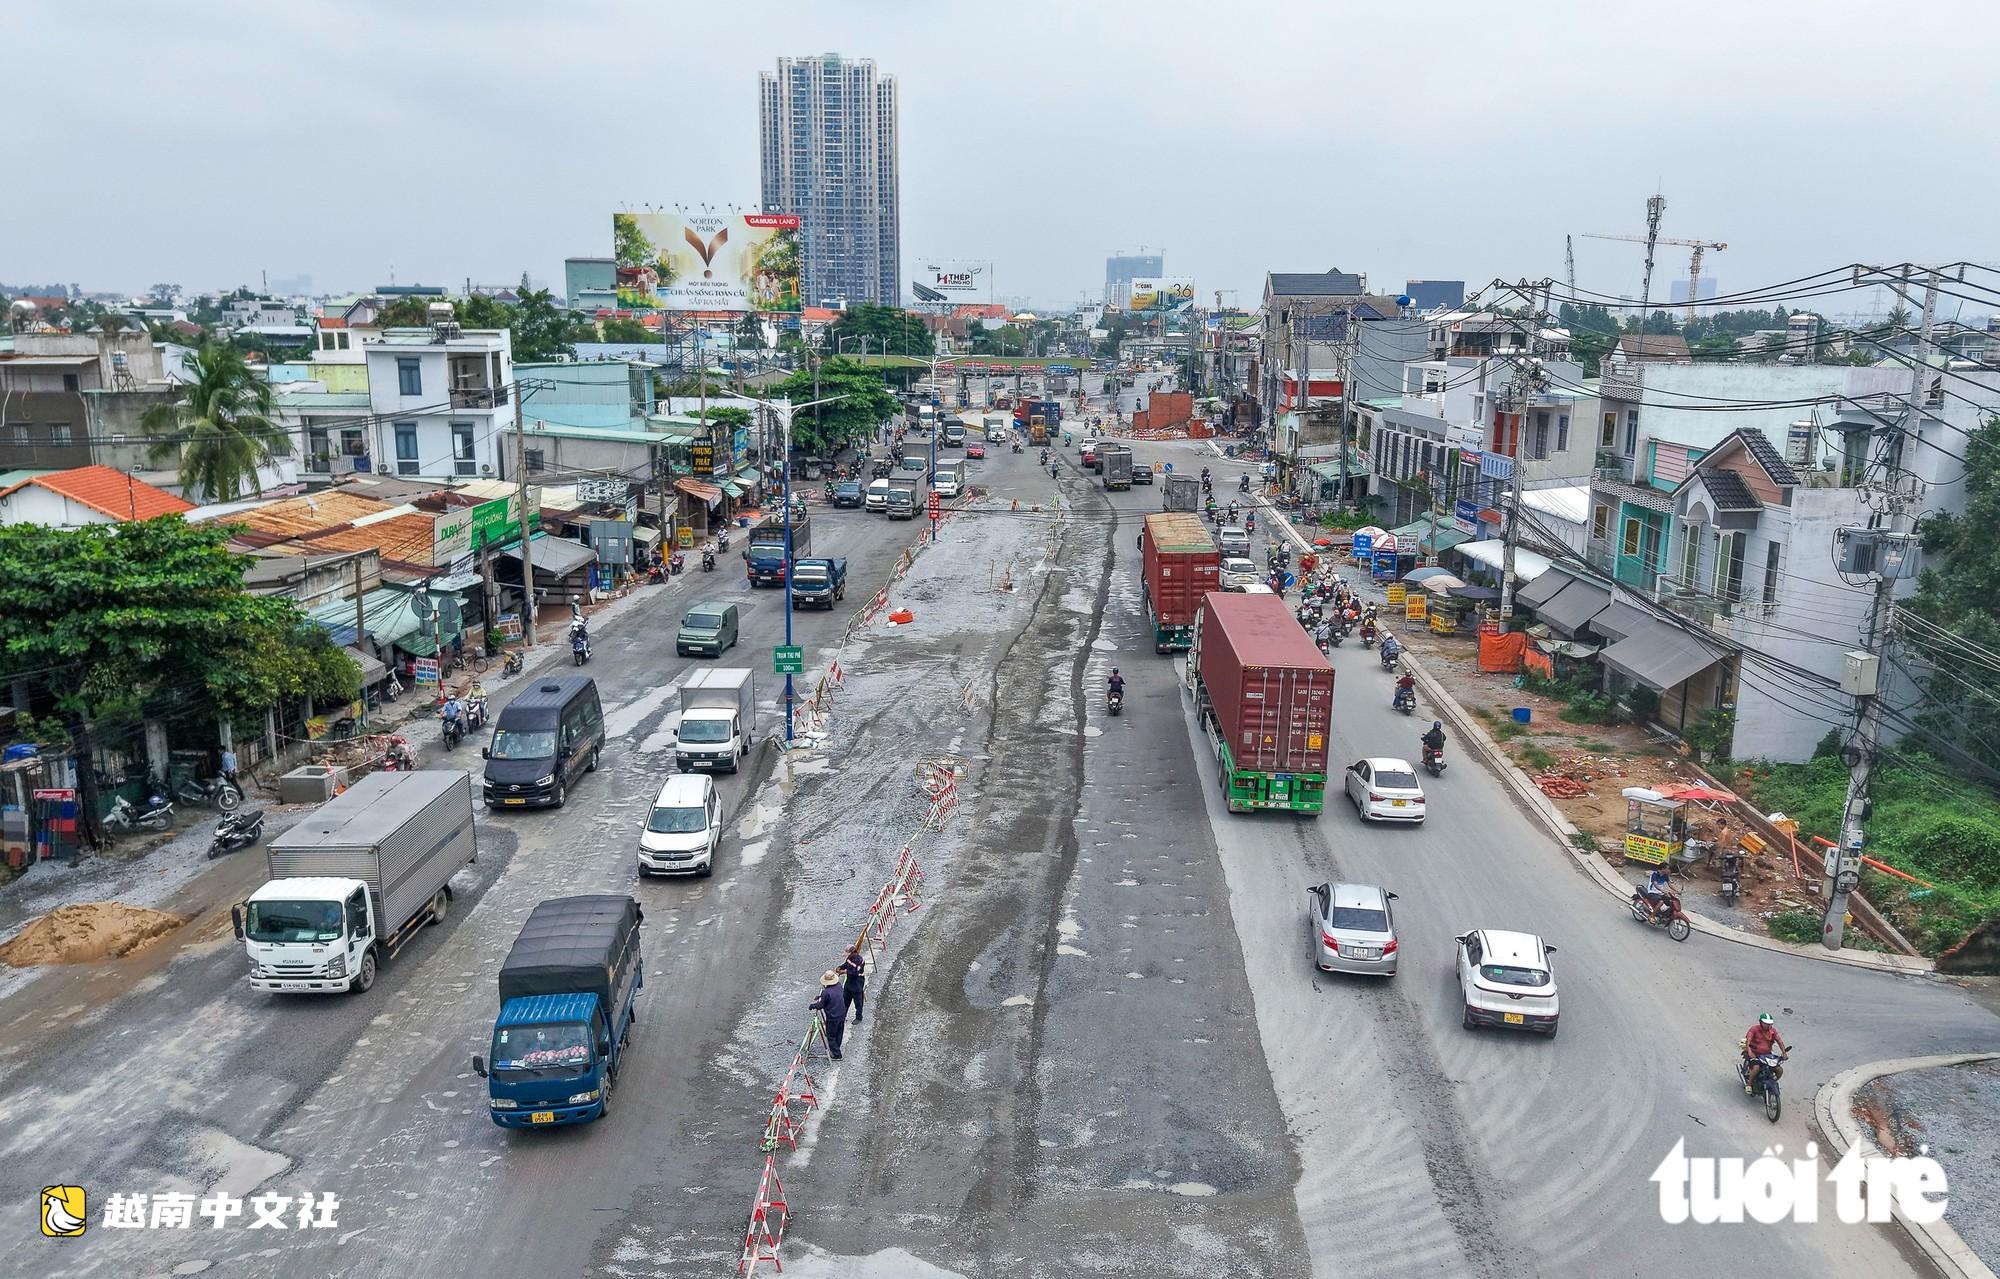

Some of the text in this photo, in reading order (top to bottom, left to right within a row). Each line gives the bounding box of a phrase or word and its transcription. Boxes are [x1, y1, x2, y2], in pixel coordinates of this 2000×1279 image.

[689, 217, 723, 225] NORTON
[696, 225, 716, 233] PARK
[949, 273, 970, 281] THÉP
[695, 457, 711, 466] PHÁT
